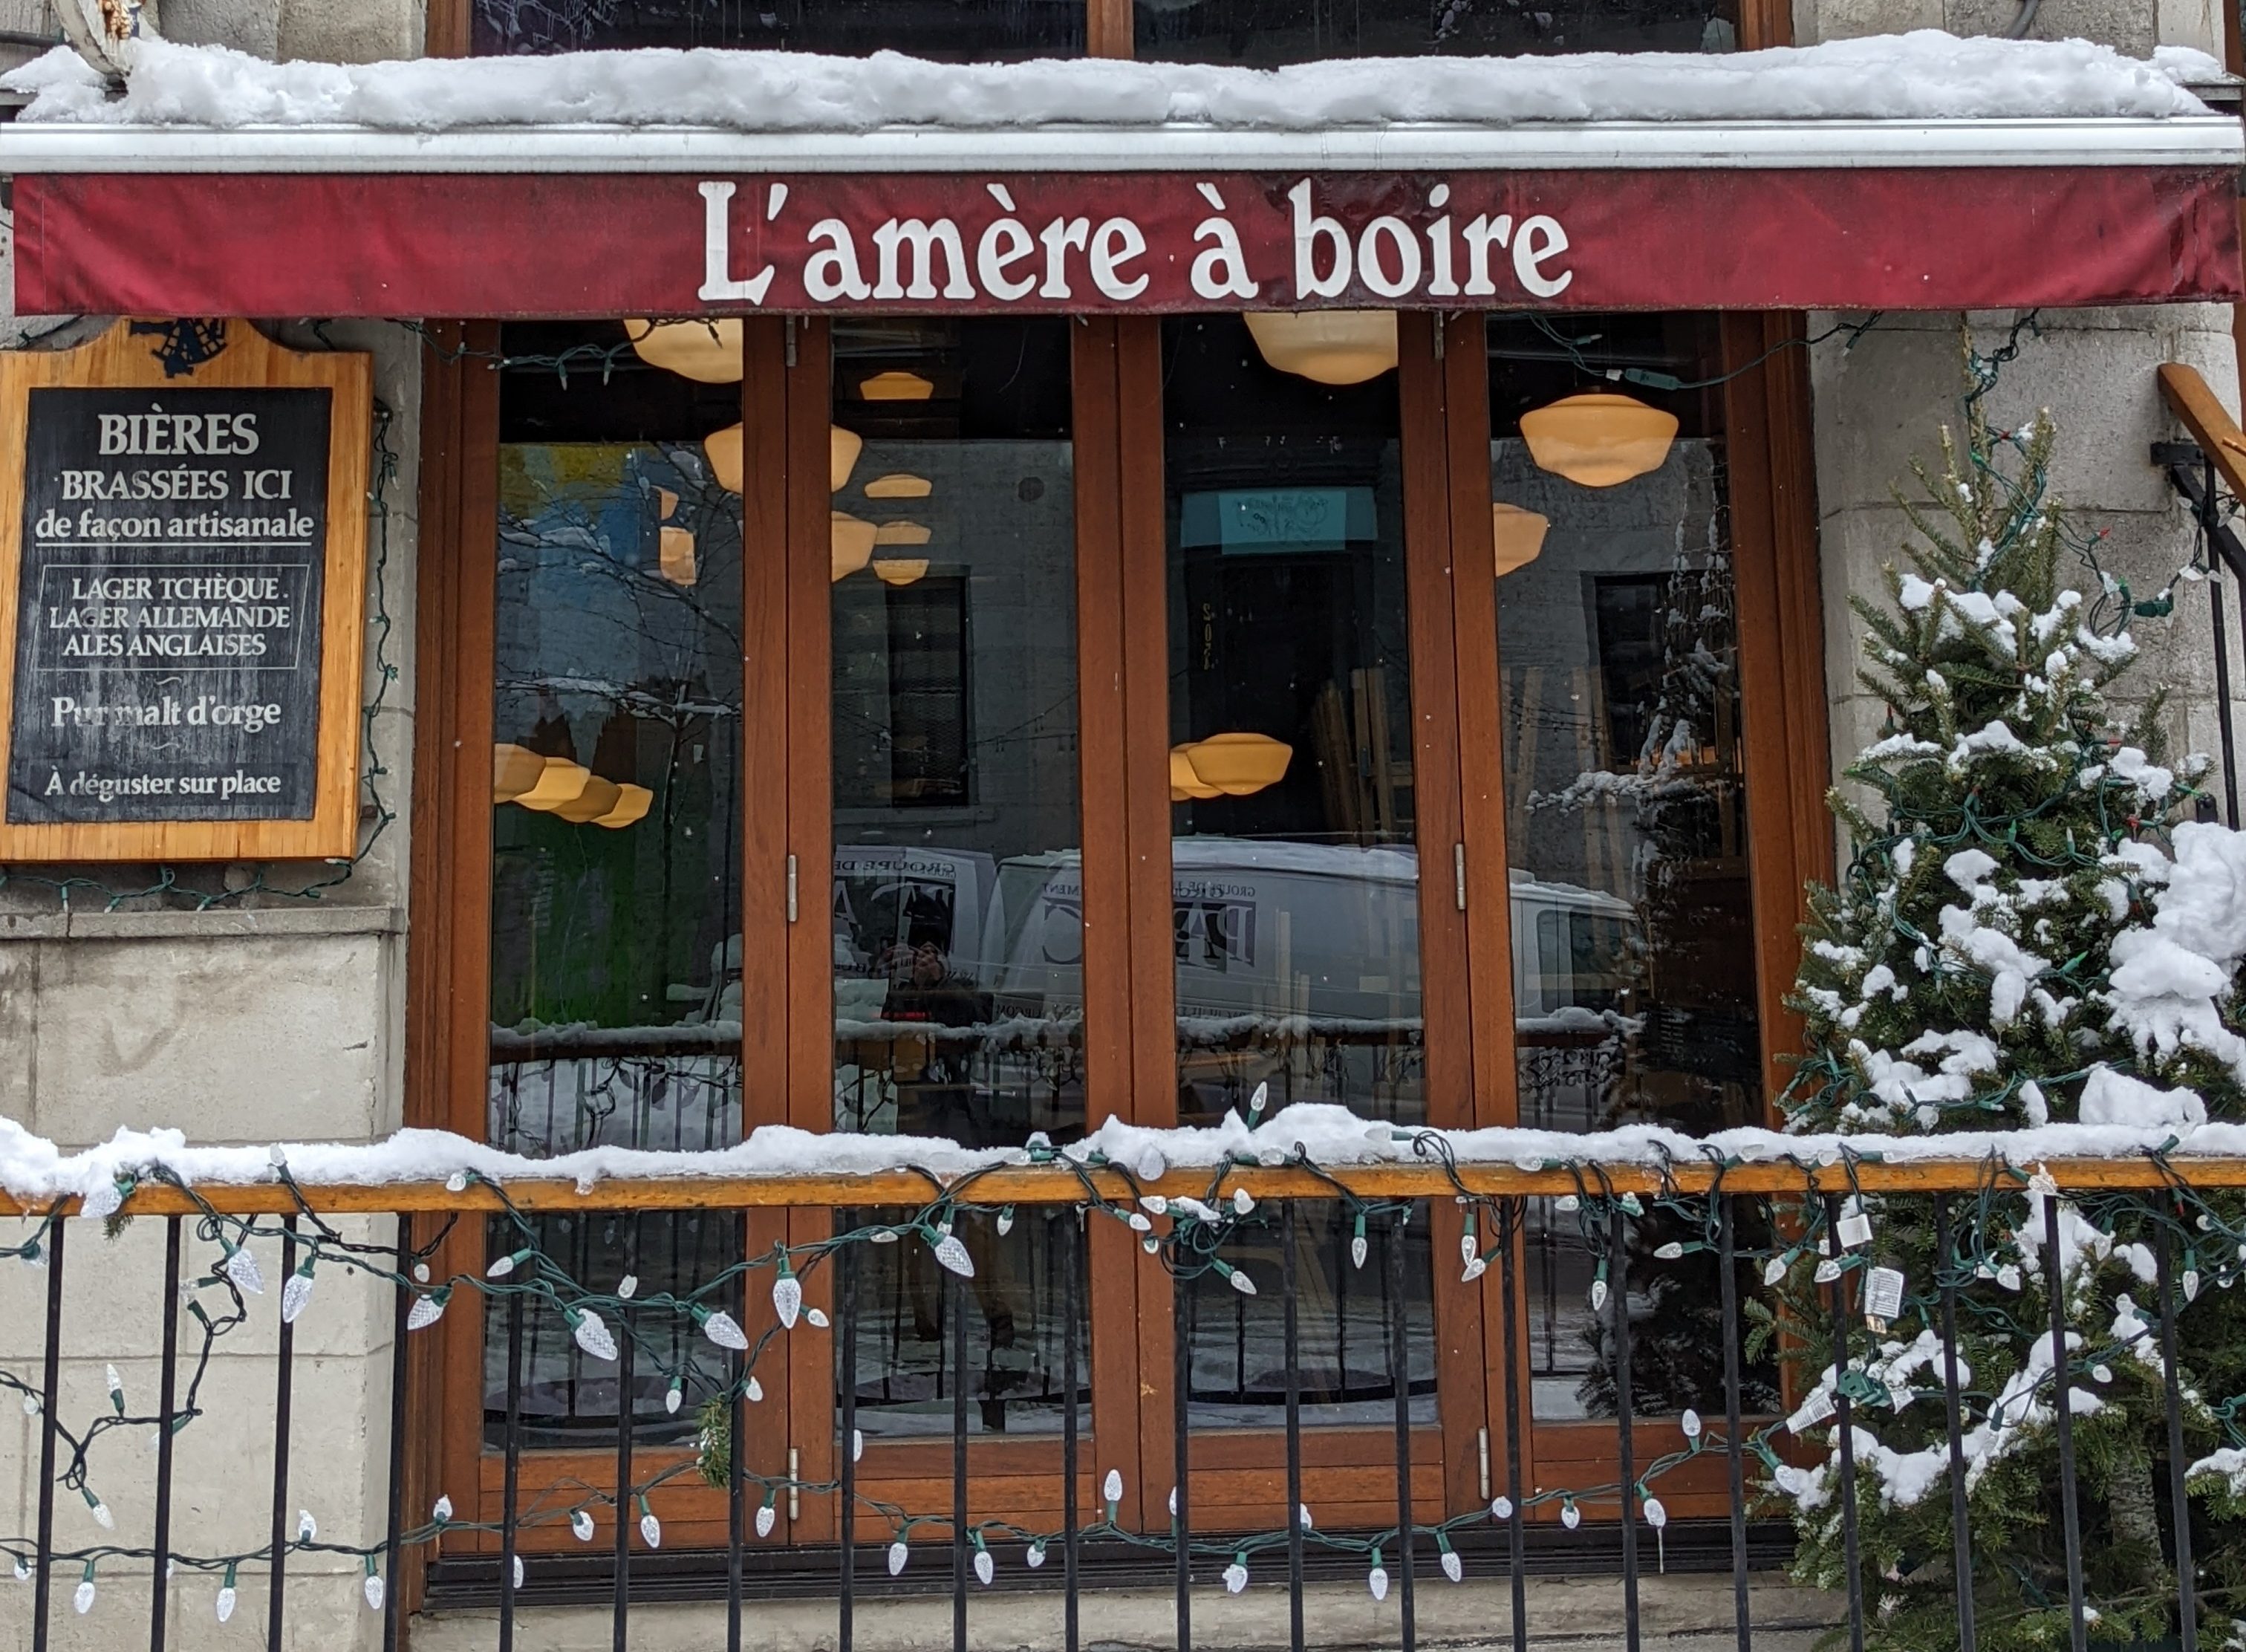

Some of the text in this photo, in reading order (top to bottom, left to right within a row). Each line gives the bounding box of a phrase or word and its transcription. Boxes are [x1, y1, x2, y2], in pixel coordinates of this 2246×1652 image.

[697, 177, 1573, 306] L'amère à boire
[97, 402, 260, 456] BIÈRES
[61, 463, 293, 501] BRASSÉES ICI
[35, 508, 315, 542] de façon artisanale
[72, 578, 152, 600] LAGER
[49, 605, 290, 628] LAGER ALLEMANDE
[62, 633, 267, 656] ALES ANGLAISES
[114, 696, 182, 726] malt
[186, 696, 281, 734] d'orge
[44, 765, 281, 803] À déguster sur place
